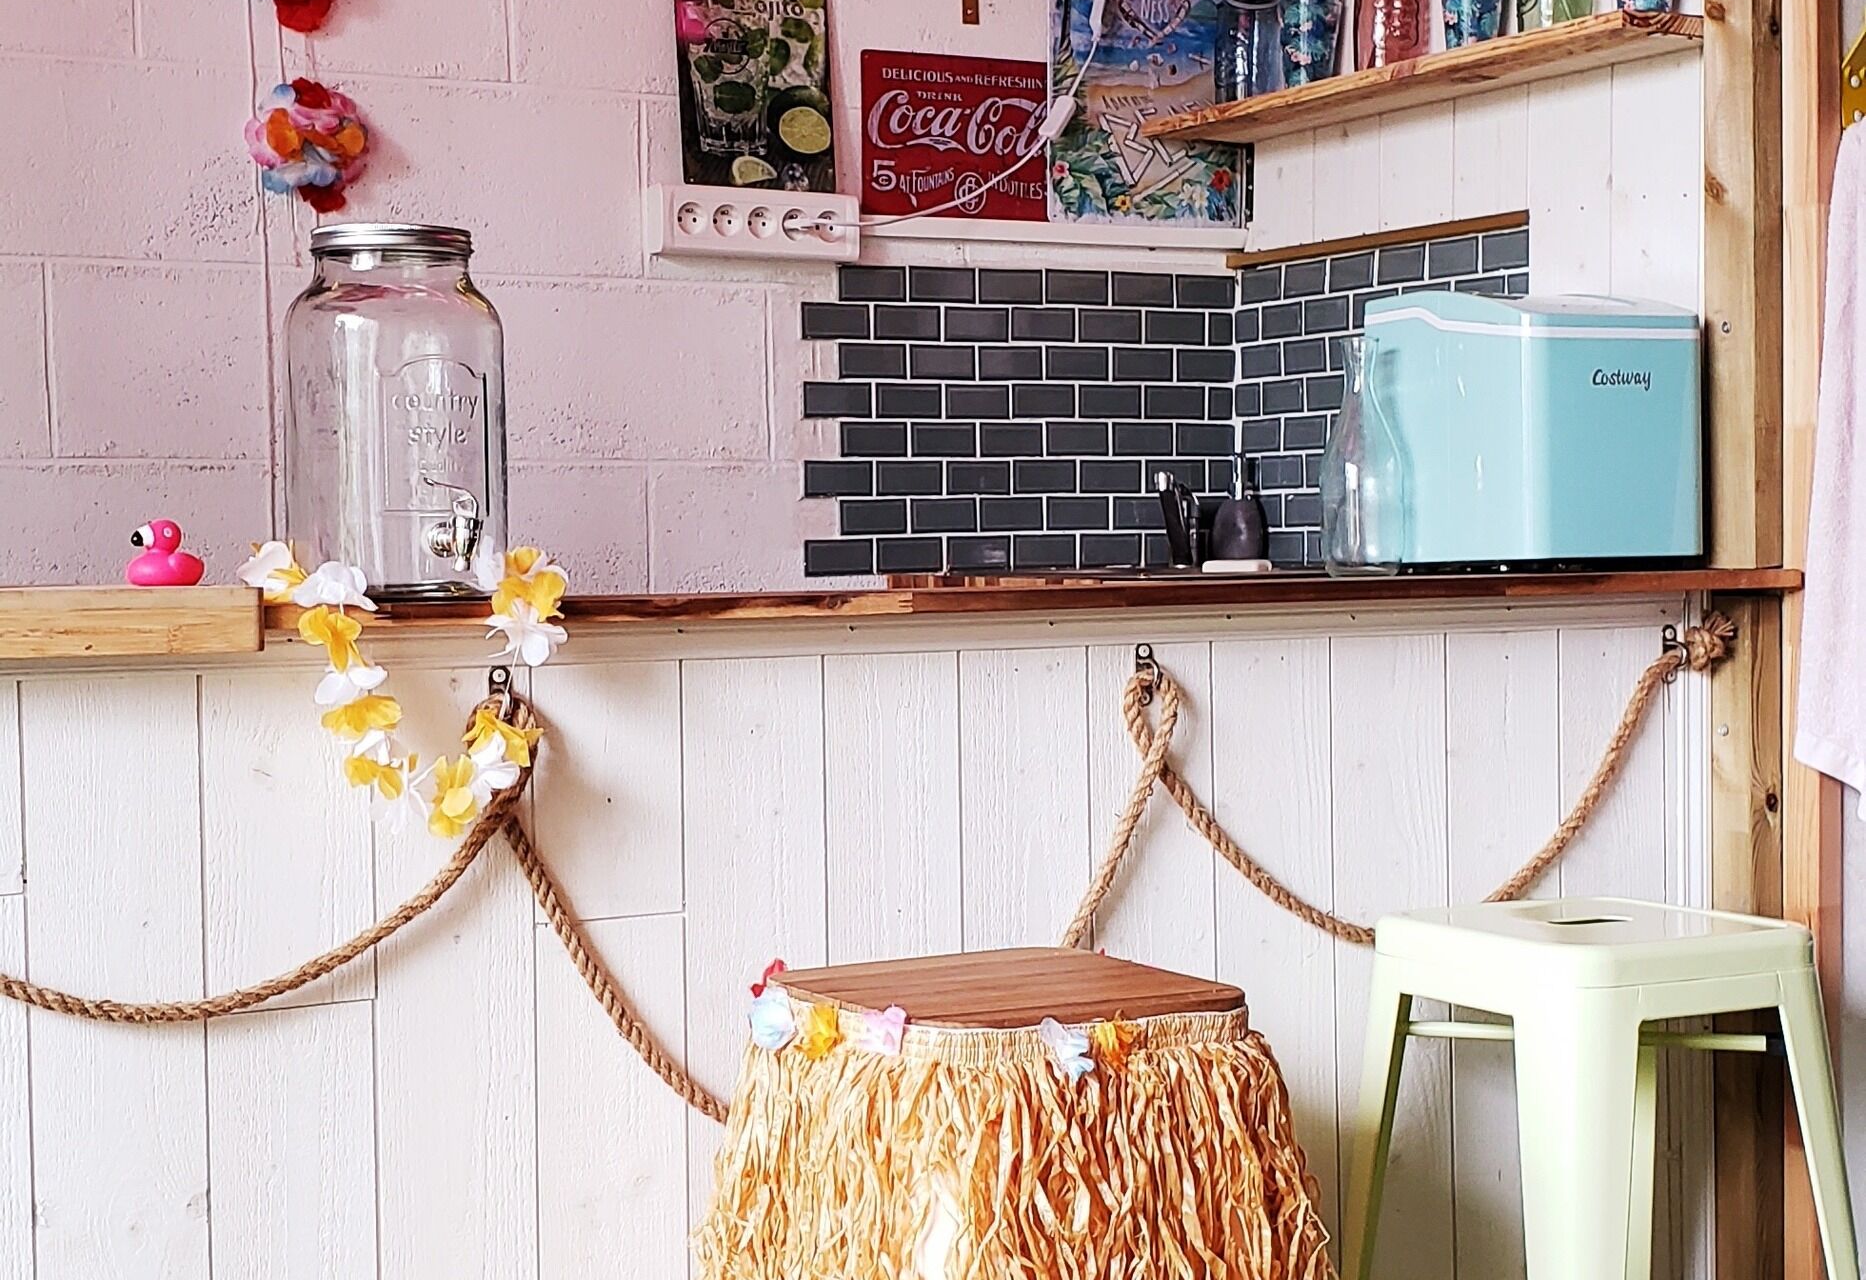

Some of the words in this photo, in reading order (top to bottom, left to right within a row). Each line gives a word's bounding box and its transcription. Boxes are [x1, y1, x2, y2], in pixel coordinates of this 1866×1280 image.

[881, 67, 954, 84] DELICIOUS
[955, 74, 974, 84] AND
[974, 73, 1046, 90] REFRESHIN
[916, 90, 963, 102] DRINK
[867, 89, 1047, 158] Coca-Col
[1591, 368, 1652, 392] Costway
[407, 420, 467, 454] style
